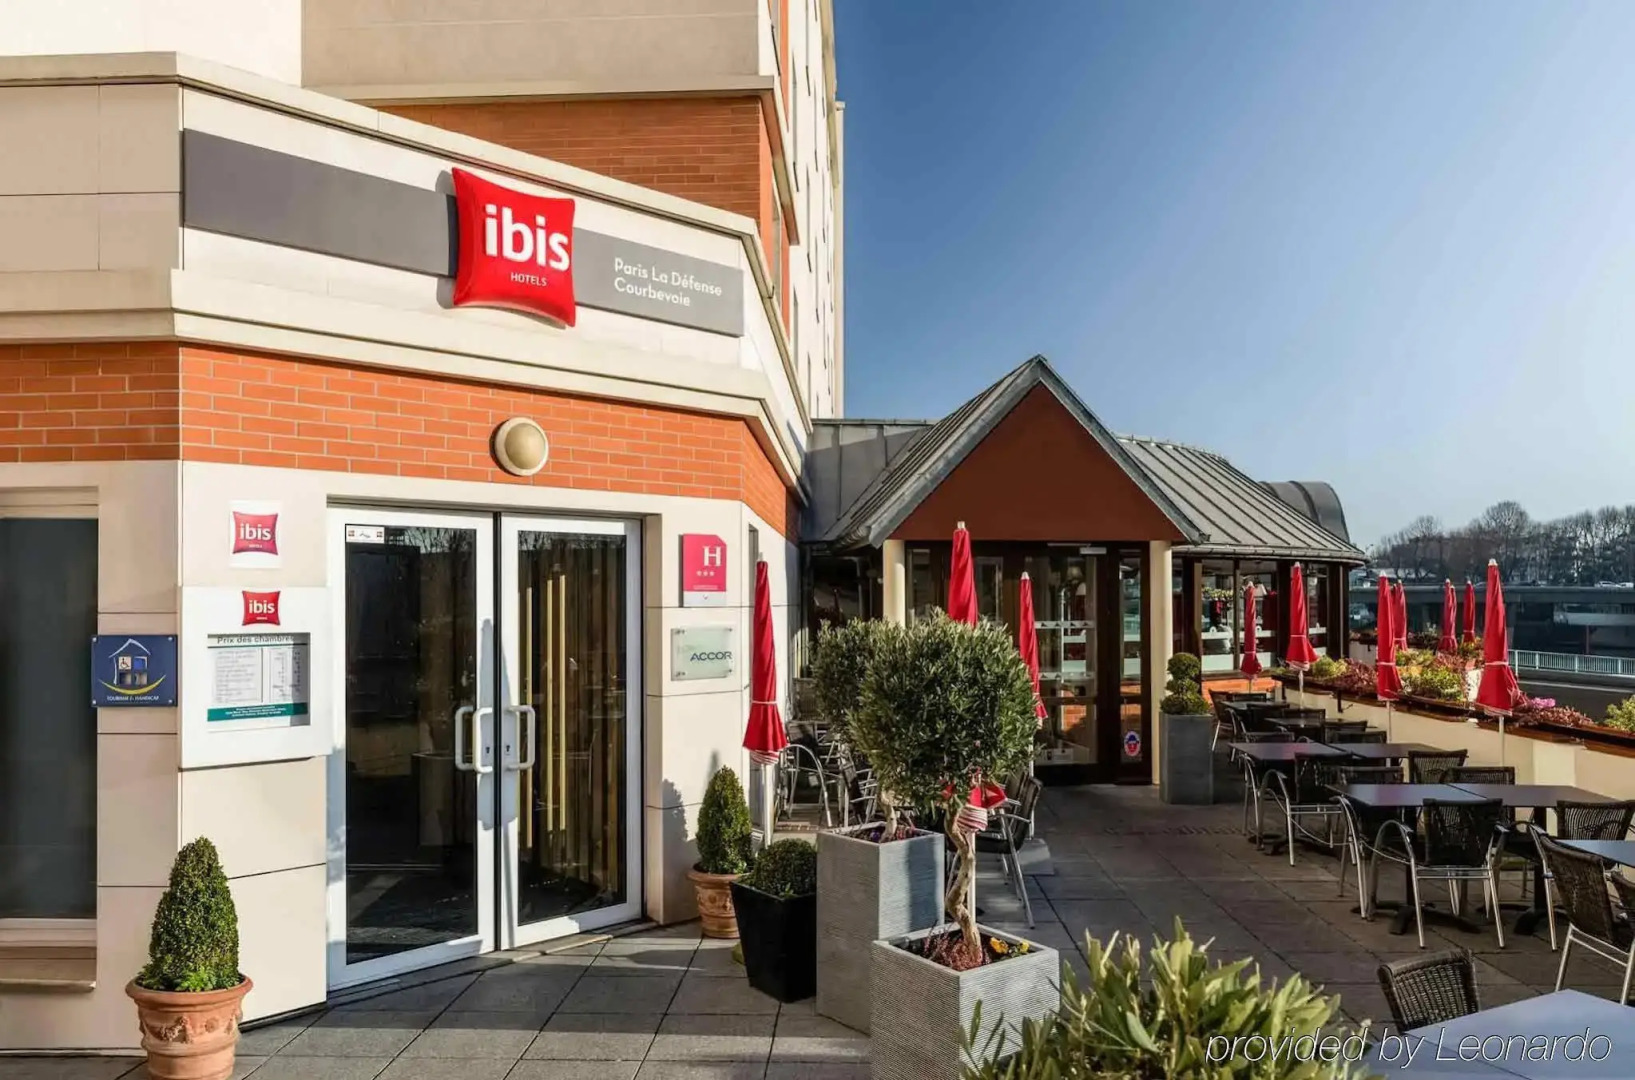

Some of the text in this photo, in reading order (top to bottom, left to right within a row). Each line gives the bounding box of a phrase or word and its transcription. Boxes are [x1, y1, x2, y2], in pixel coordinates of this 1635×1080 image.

[485, 203, 570, 272] ibis
[510, 271, 547, 287] HOTELS
[614, 257, 722, 296] Paris La Défense
[614, 277, 691, 306] Courbevoie
[240, 523, 271, 541] ibis
[702, 545, 722, 567] H
[248, 600, 275, 614] ibis
[690, 651, 732, 661] ACCOR
